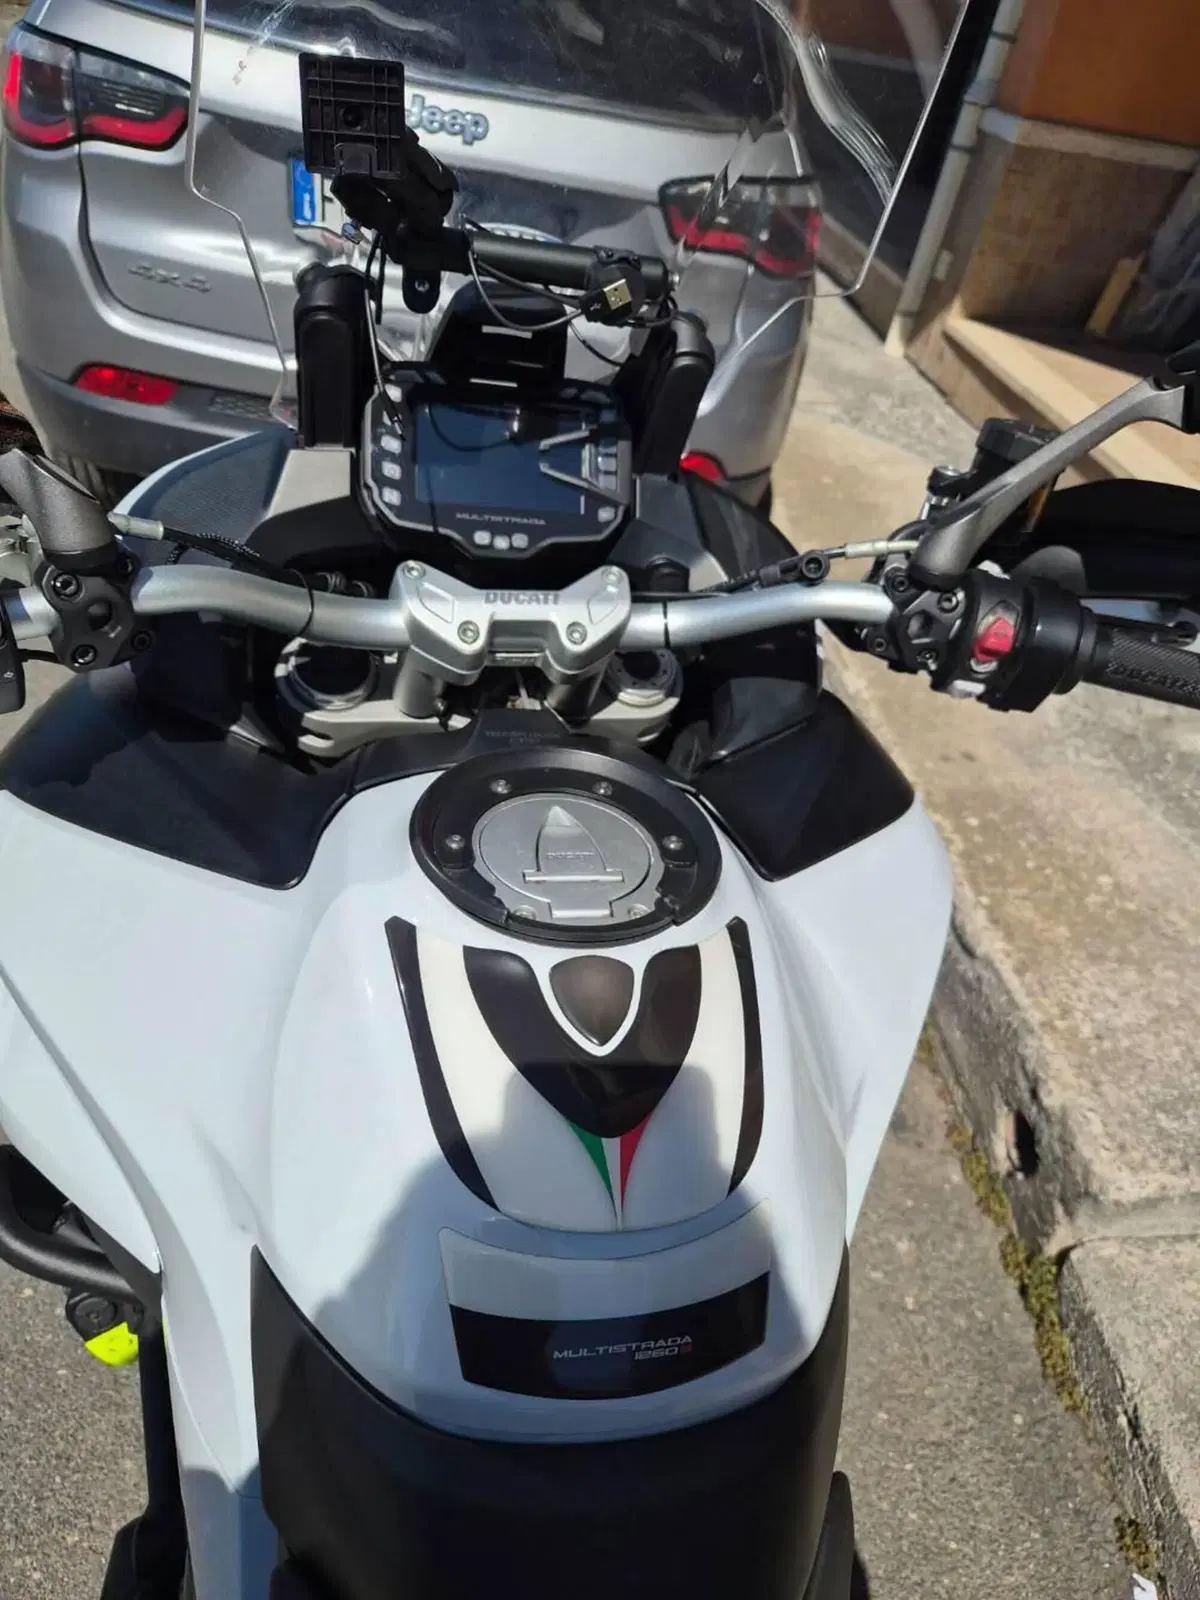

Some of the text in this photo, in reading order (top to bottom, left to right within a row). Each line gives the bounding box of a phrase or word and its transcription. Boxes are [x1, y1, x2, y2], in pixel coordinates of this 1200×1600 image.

[405, 94, 488, 145] Jeep
[484, 591, 560, 606] DUCATI
[553, 1335, 693, 1360] MULTISTRADA
